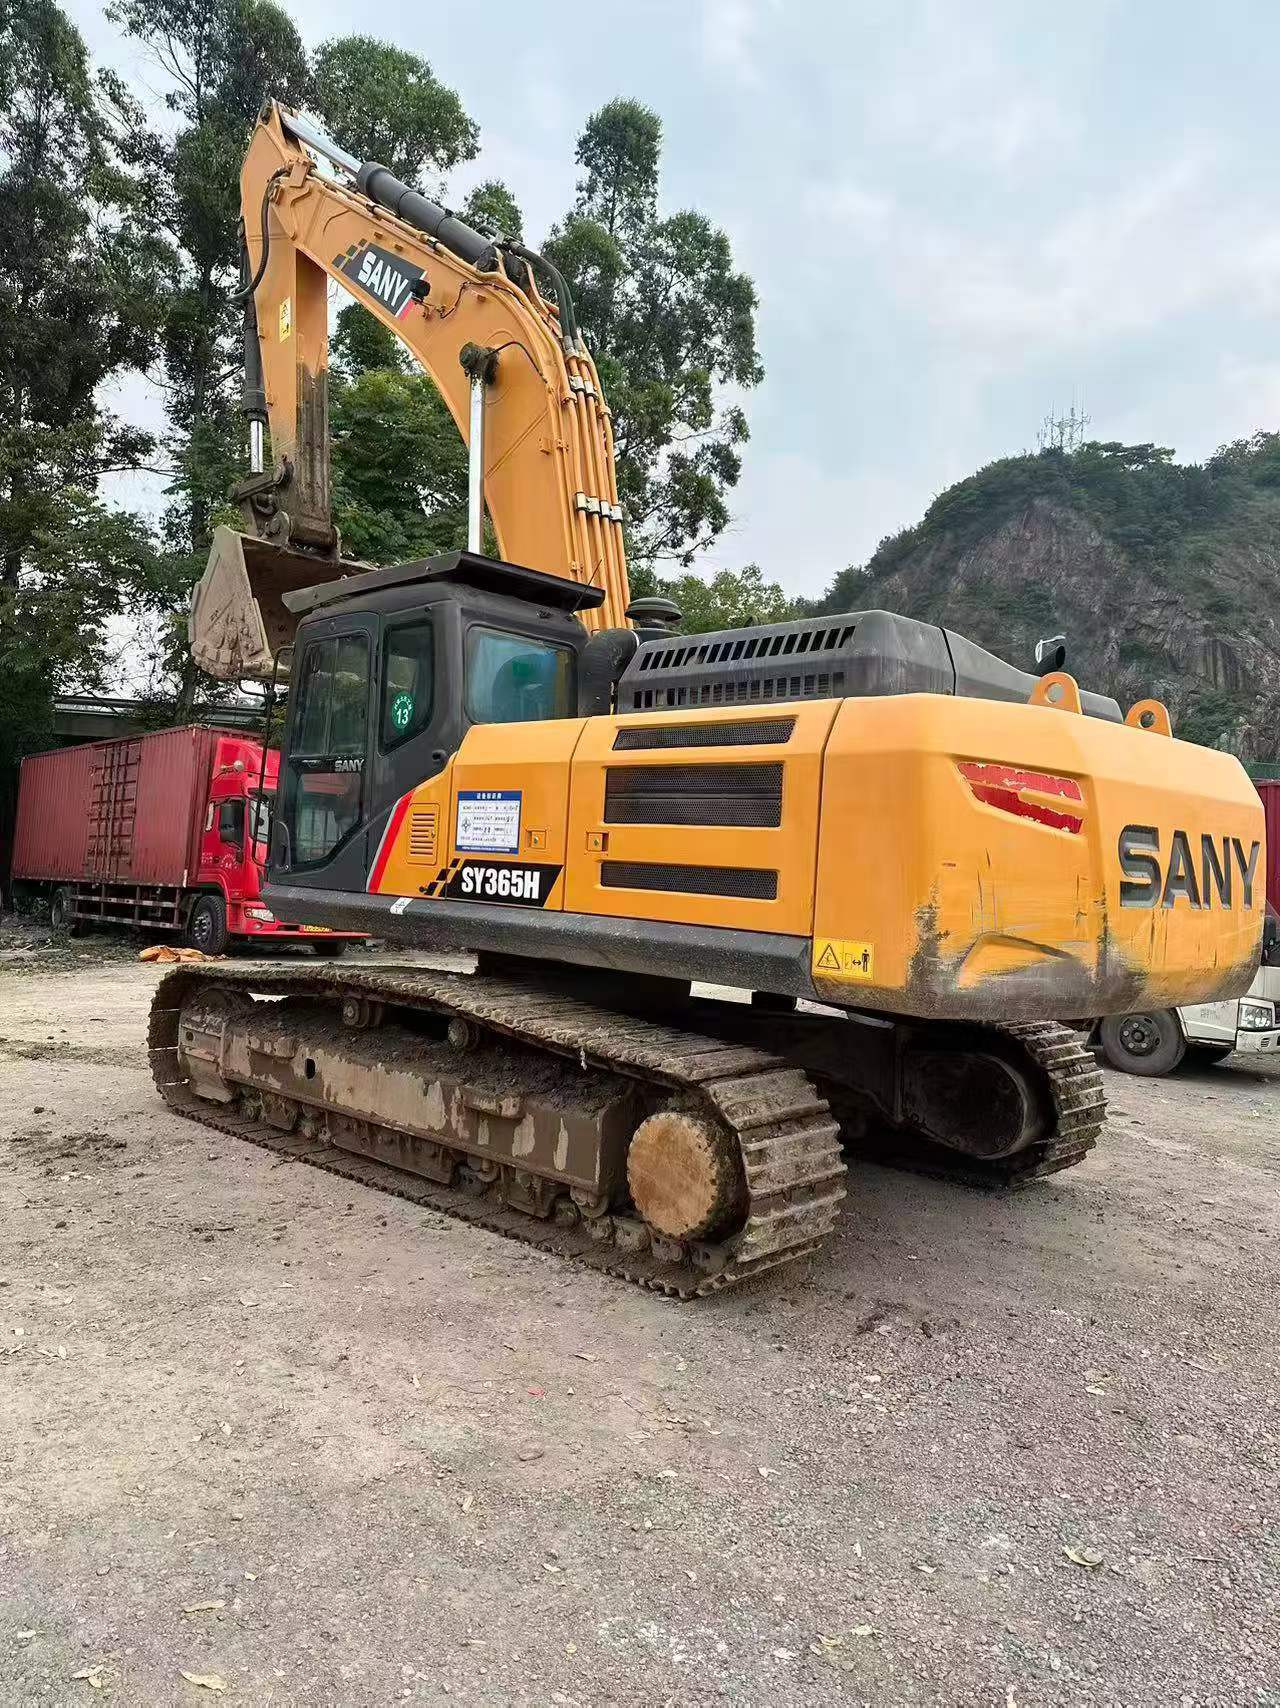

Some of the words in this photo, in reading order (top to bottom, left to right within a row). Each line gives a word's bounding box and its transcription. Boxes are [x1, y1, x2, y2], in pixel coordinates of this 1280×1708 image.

[358, 251, 409, 307] SANY
[396, 708, 409, 724] 13
[335, 759, 364, 772] SANY
[461, 866, 540, 900] SY365H
[1118, 824, 1261, 910] SANY
